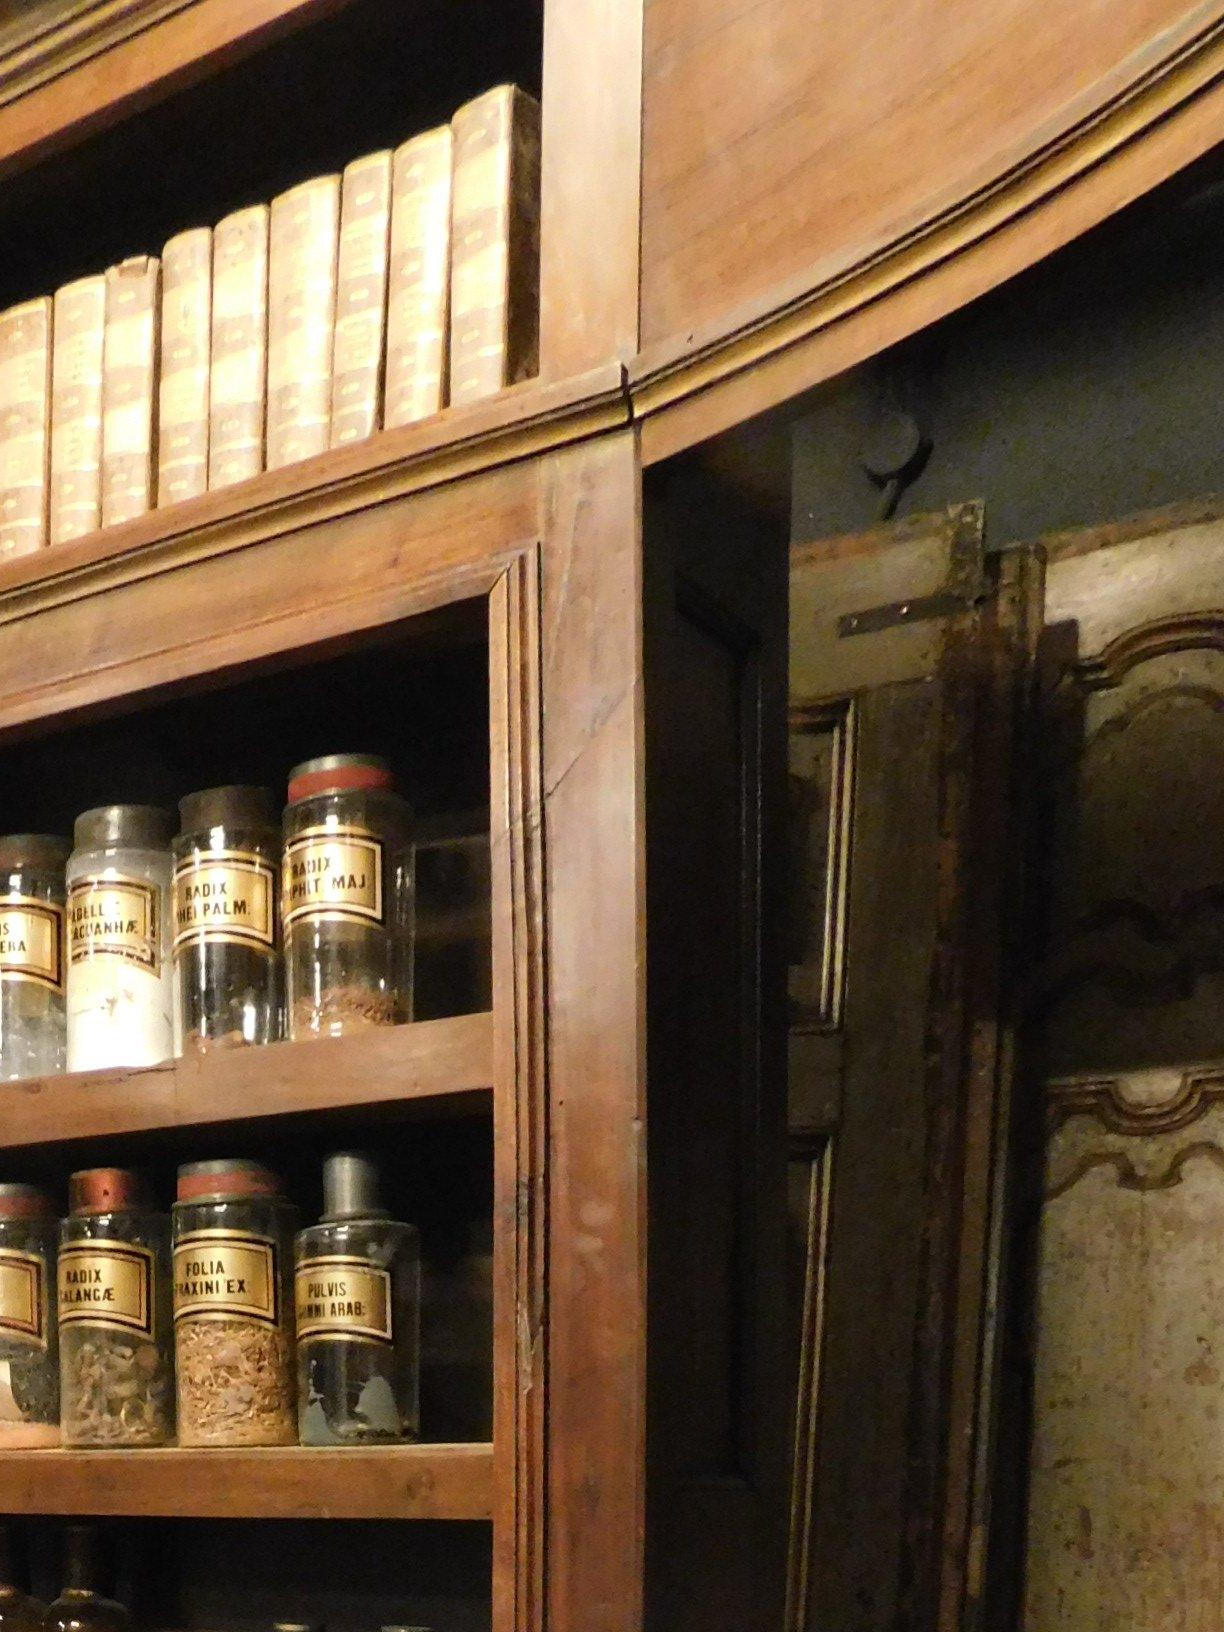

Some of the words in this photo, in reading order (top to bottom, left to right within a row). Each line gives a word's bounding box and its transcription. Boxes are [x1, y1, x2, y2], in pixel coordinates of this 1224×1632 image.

[185, 881, 228, 902] RADIX
[65, 1268, 103, 1285] RADIX
[186, 1260, 225, 1278] FOLIA
[308, 1281, 347, 1299] PULVIS
